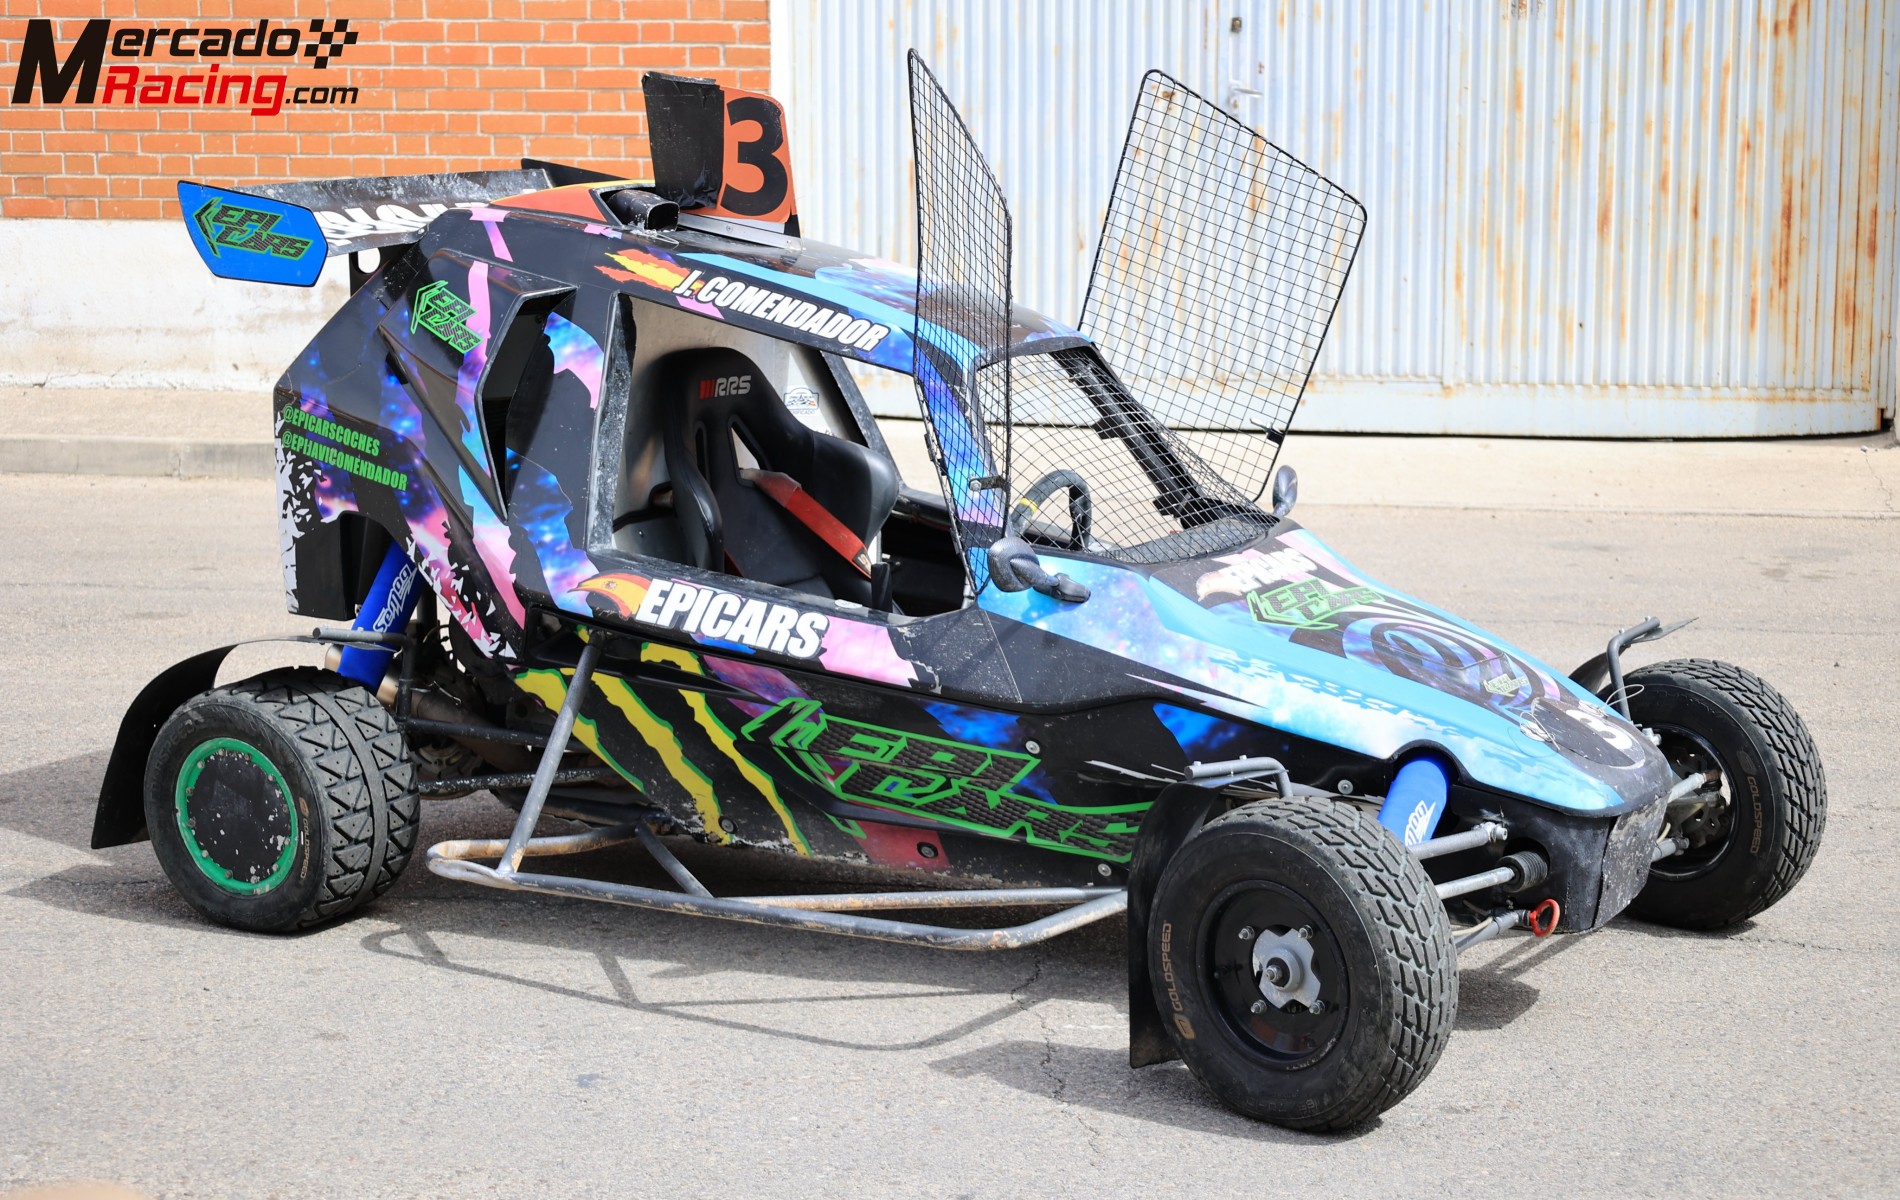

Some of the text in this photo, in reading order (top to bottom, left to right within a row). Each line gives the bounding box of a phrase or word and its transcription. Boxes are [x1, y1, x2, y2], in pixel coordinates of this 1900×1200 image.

[720, 96, 788, 216] 3
[212, 204, 283, 232] EPI
[215, 226, 313, 260] CARS
[418, 307, 485, 354] CARS
[426, 287, 478, 323] EPI
[673, 270, 890, 352] J. COMENDADOR
[714, 375, 751, 398] RRS
[283, 404, 381, 457] @EPICARSCOCHES
[634, 578, 830, 658] EPICARS
[1260, 577, 1330, 613] EPI
[1297, 586, 1386, 622] CARS
[806, 714, 1040, 792] EPI
[1748, 775, 1763, 855] GOLDSPEED
[300, 818, 310, 880] GOLDSPEED
[1161, 922, 1184, 1012] GOLDSPEED
